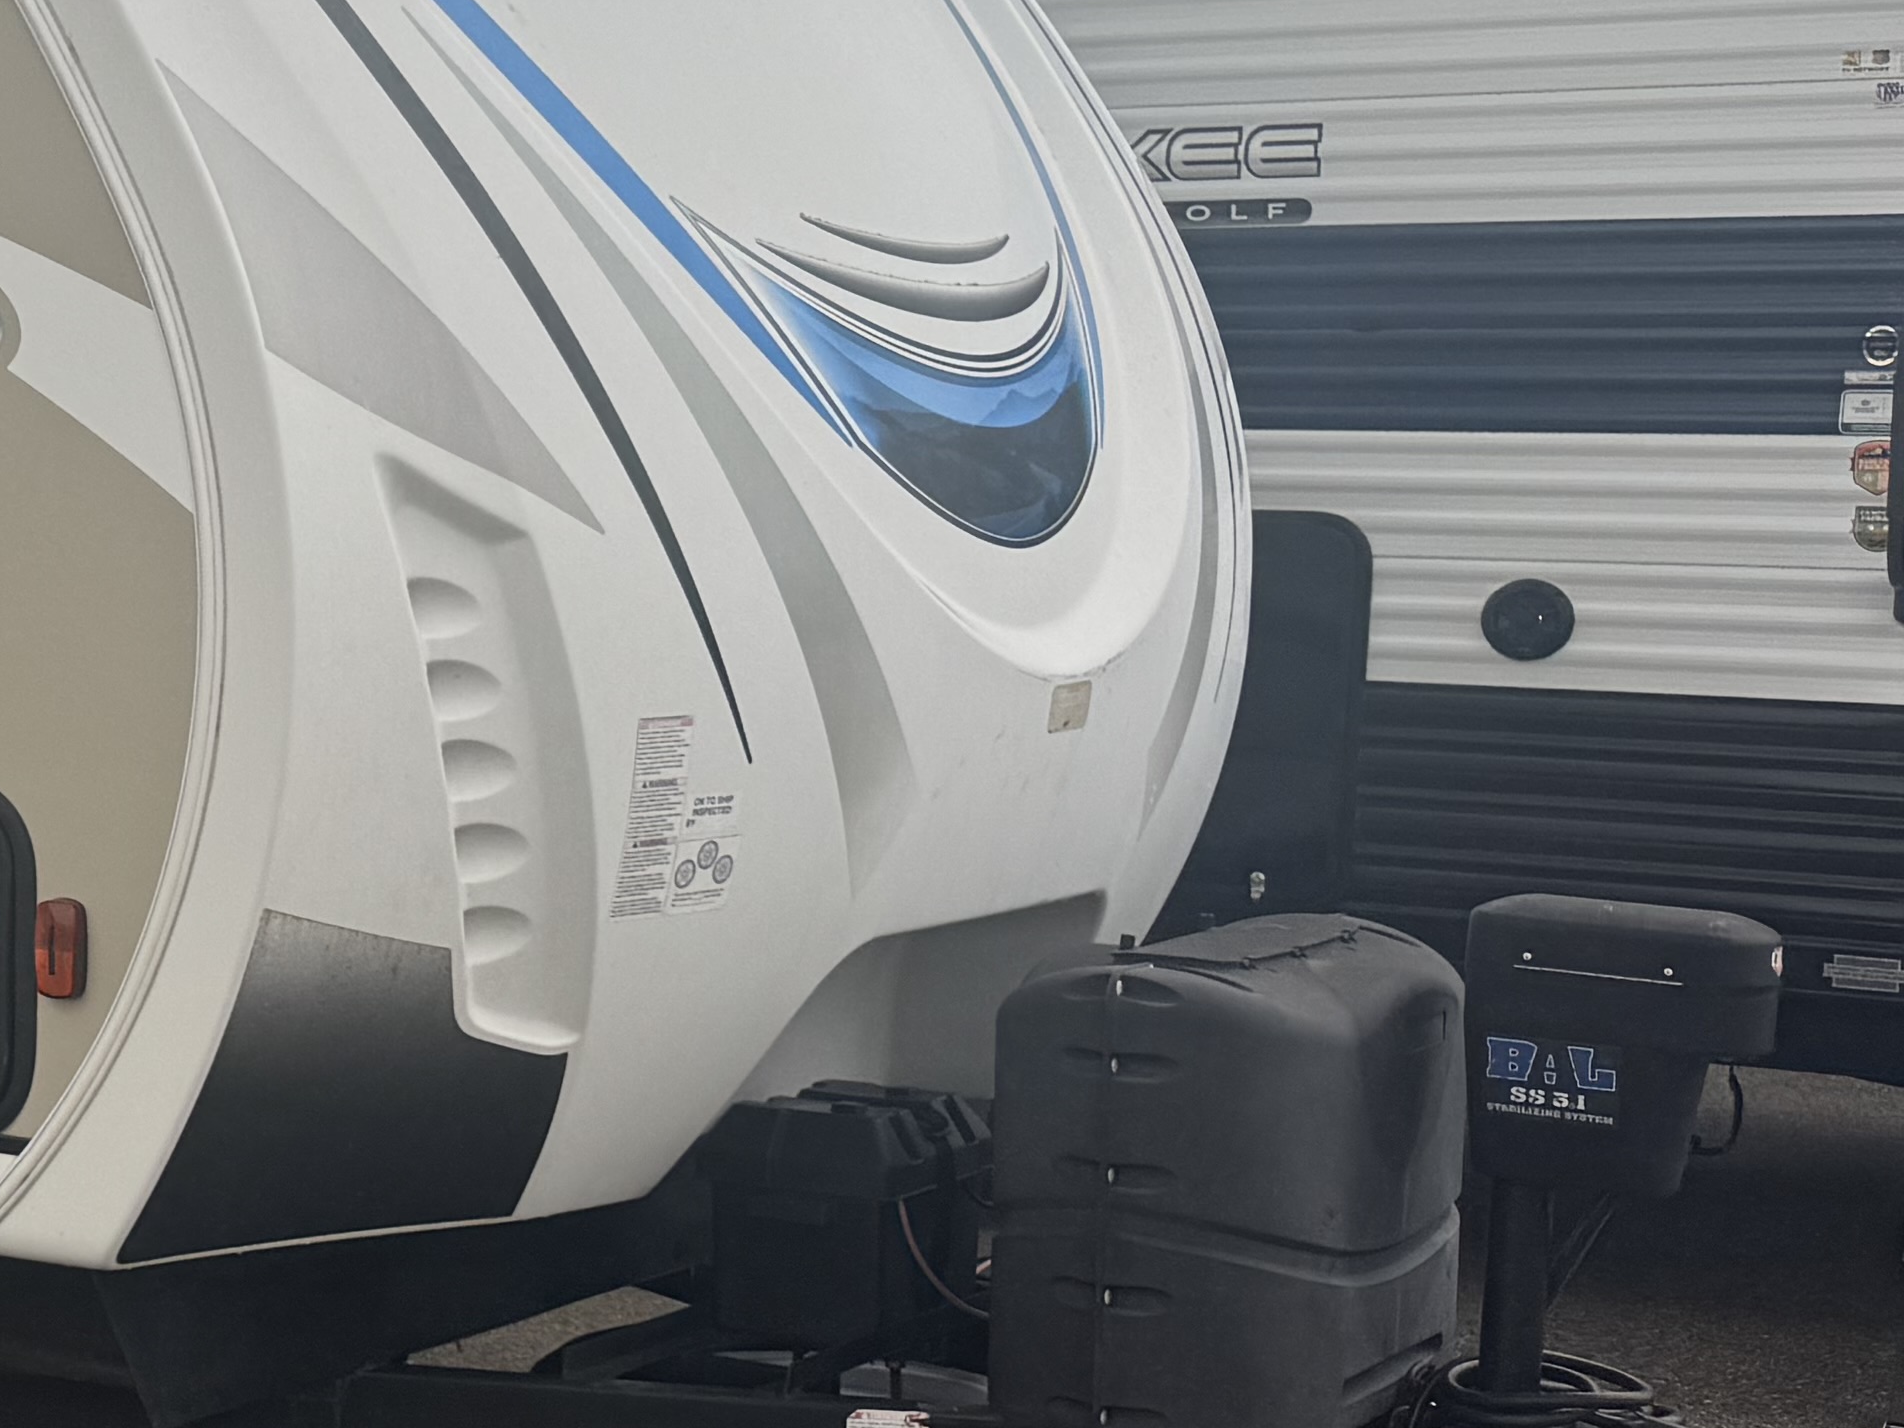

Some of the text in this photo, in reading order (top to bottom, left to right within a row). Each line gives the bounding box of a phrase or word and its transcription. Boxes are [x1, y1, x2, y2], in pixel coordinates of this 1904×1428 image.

[1486, 1036, 1616, 1092] BAL
[1509, 1085, 1546, 1105] SS
[1564, 1111, 1614, 1126] SYSTEM
